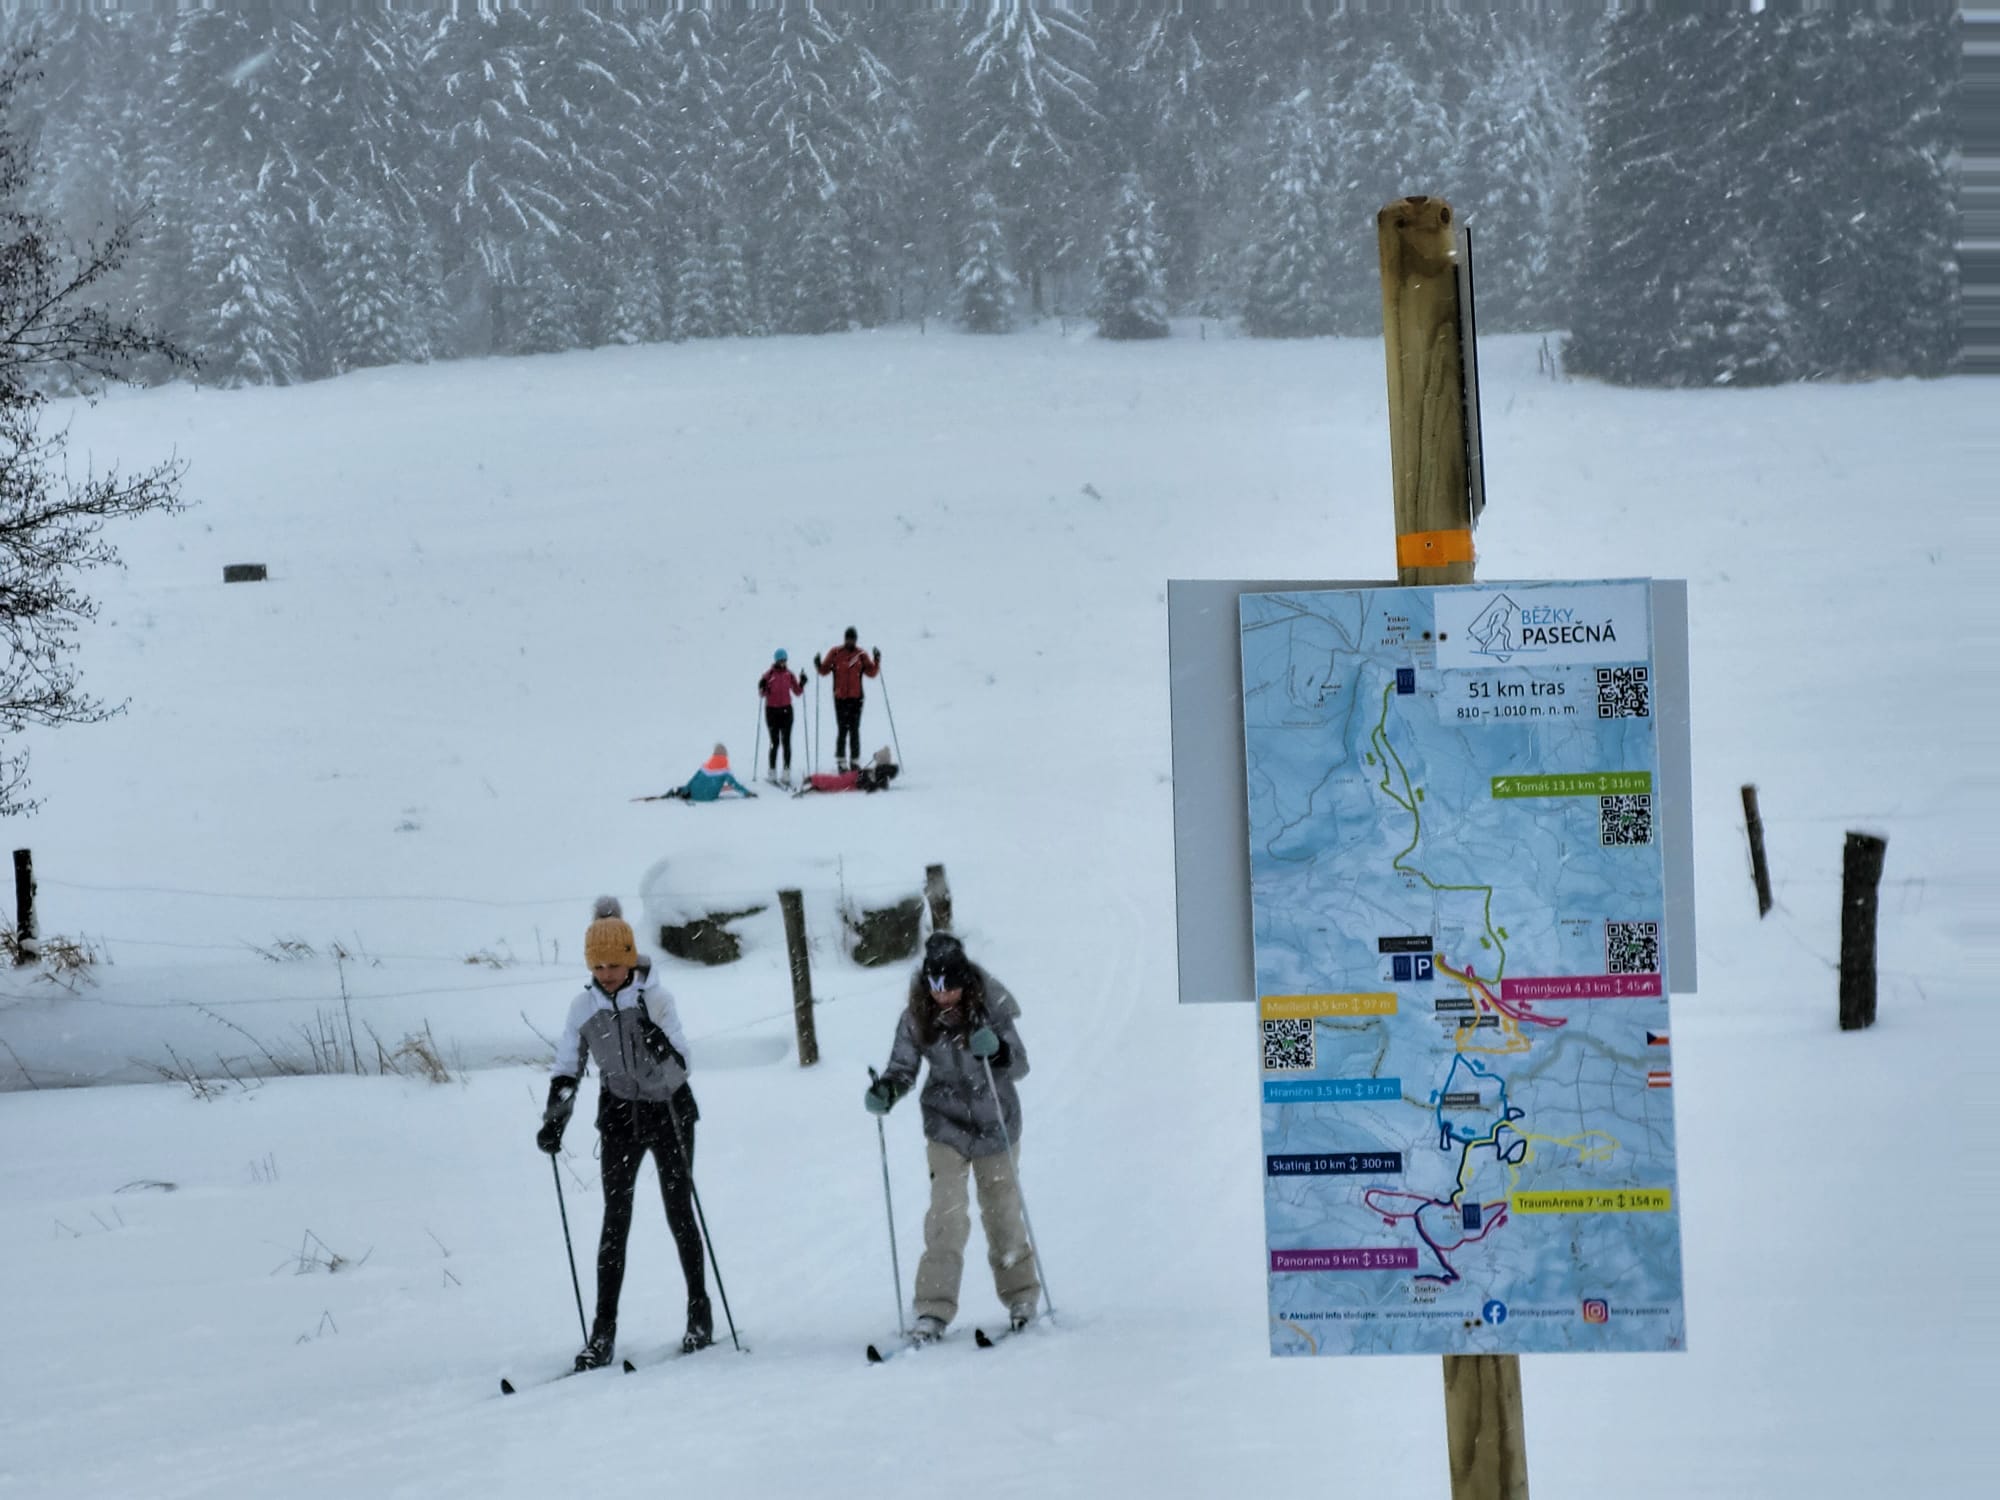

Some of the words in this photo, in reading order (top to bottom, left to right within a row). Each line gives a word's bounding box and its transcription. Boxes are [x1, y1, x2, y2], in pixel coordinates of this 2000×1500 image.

[1521, 605, 1574, 625] BĚŽKY
[1522, 619, 1616, 645] PASEČNÁ
[1469, 682, 1490, 698] 51
[1497, 680, 1525, 697] km
[1531, 680, 1565, 696] tras
[1457, 707, 1479, 719] 810
[1494, 705, 1527, 718] 1.010
[1530, 706, 1545, 716] m.
[1549, 705, 1560, 715] n.
[1563, 704, 1579, 715] m.
[1516, 780, 1550, 792] Tomáš
[1553, 780, 1575, 792] 13,1
[1578, 779, 1595, 789] km
[1611, 777, 1631, 789] 316
[1634, 779, 1646, 788] m
[1418, 958, 1431, 976] P
[1514, 982, 1572, 995] Tréninková
[1594, 982, 1611, 993] km
[1627, 981, 1641, 991] 45
[1332, 1000, 1348, 1010] km
[1380, 1001, 1391, 1009] m
[1335, 1085, 1352, 1096] km
[1367, 1085, 1380, 1095] 87
[1383, 1086, 1394, 1094] m
[1272, 1160, 1311, 1172] Skating
[1314, 1159, 1327, 1170] 10
[1330, 1159, 1346, 1169] km
[1362, 1158, 1381, 1169] 300
[1384, 1160, 1395, 1168] m
[1519, 1197, 1584, 1209] TraumArena
[1587, 1197, 1593, 1207] 7
[1595, 1197, 1613, 1207] m
[1630, 1196, 1649, 1206] 154
[1652, 1197, 1664, 1206] m
[1277, 1256, 1330, 1267] Panorama
[1333, 1255, 1340, 1265] 9
[1343, 1255, 1359, 1265] km
[1375, 1254, 1394, 1265] 153
[1397, 1255, 1408, 1264] m
